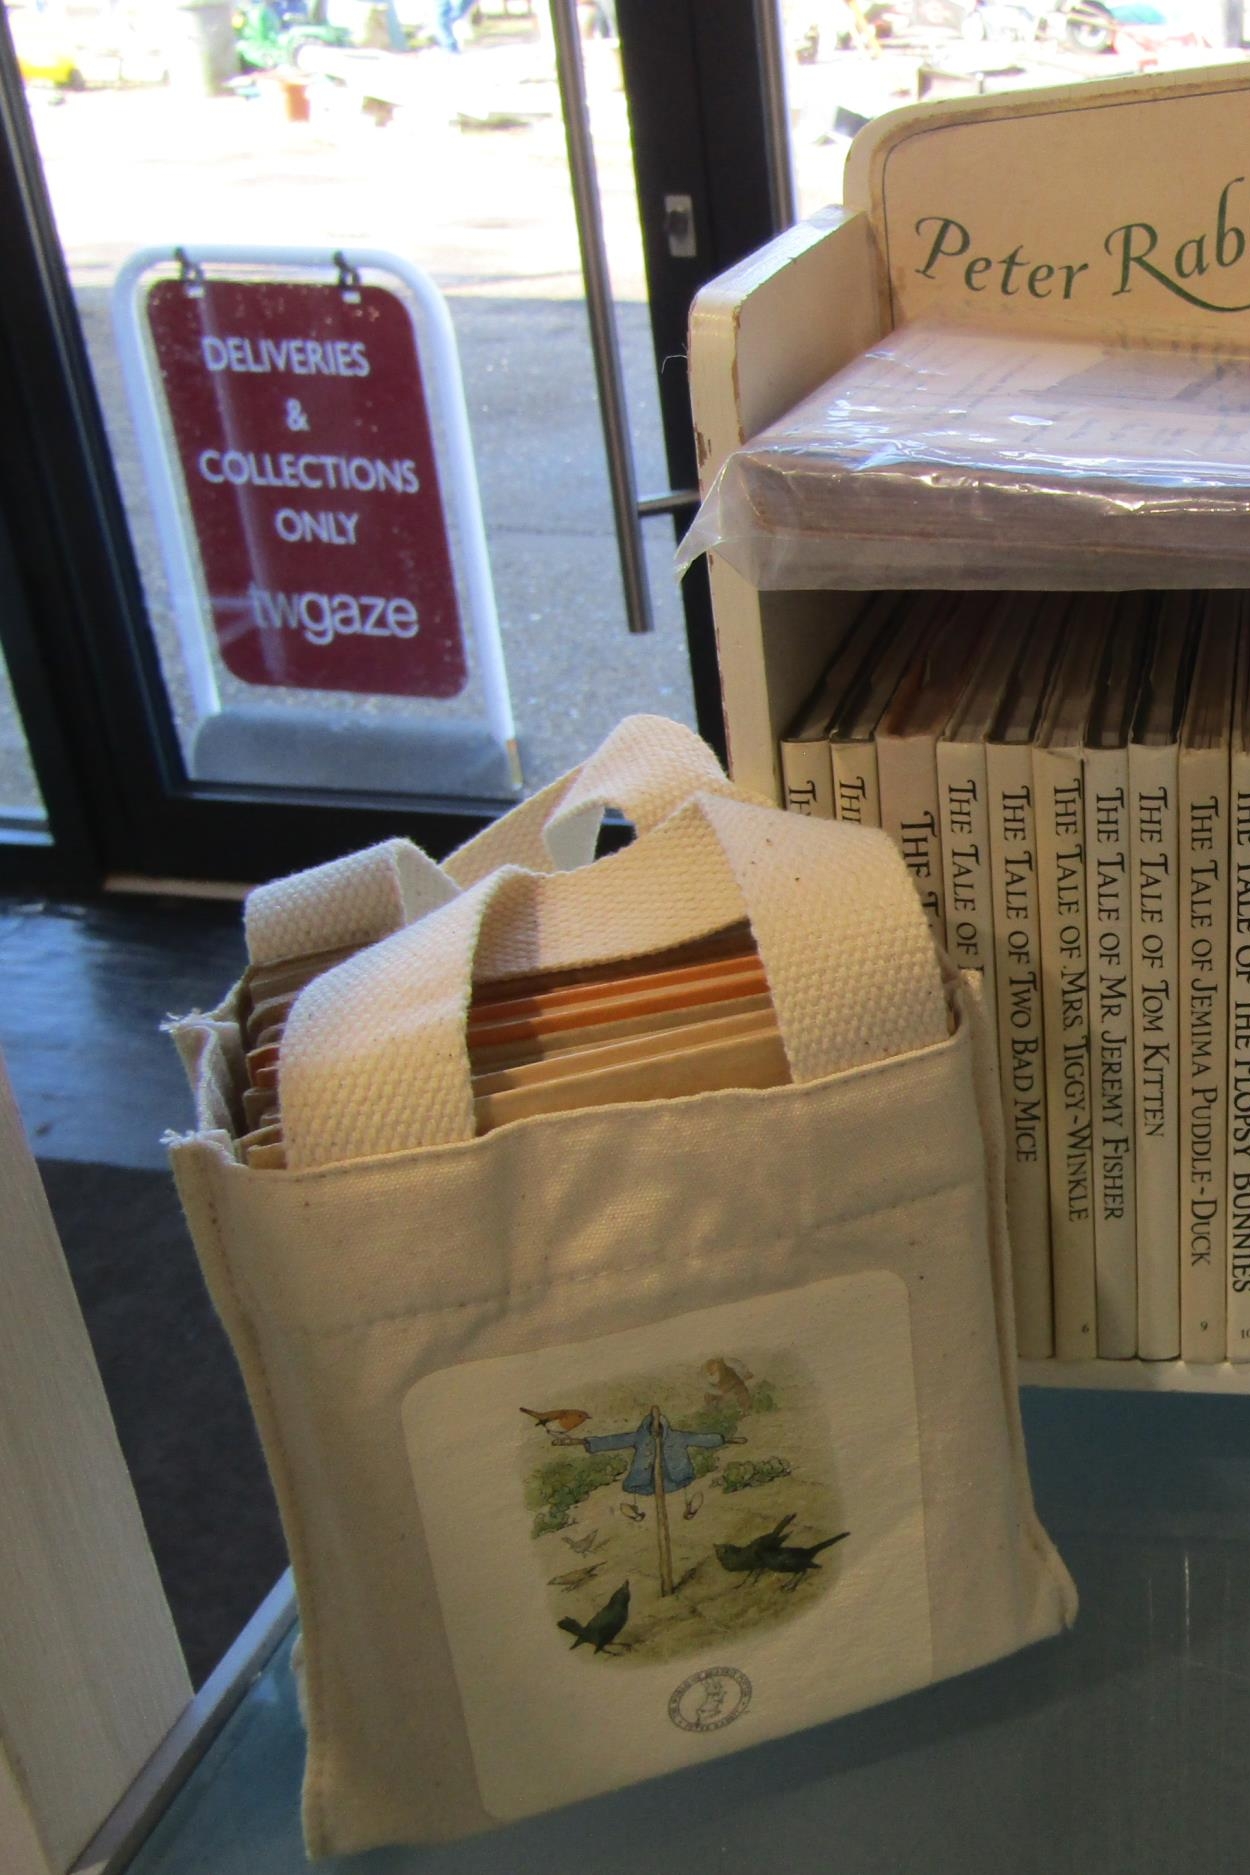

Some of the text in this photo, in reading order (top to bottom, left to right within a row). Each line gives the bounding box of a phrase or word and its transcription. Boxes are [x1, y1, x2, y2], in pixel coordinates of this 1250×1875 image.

[914, 216, 1089, 300] Peter
[202, 336, 370, 378] DELIVERIES
[285, 399, 310, 433] &
[198, 450, 419, 495] COLLECTIONS
[275, 508, 360, 545] ONLY
[248, 583, 419, 646] twgaze
[788, 780, 817, 816] TH
[839, 776, 866, 824] TH
[948, 780, 977, 835] THE
[1053, 778, 1082, 837] THE
[1096, 786, 1125, 844] THE
[1190, 796, 1219, 851] THE
[900, 810, 938, 880] THE
[951, 844, 980, 912] TALE
[1056, 844, 1085, 916] TALE
[1097, 852, 1125, 922] TALE
[1190, 859, 1219, 929] TALE
[955, 922, 979, 956] OF
[1059, 925, 1081, 959] OF
[1099, 932, 1121, 966] OF
[1139, 786, 1170, 1138] THE TALE OF TOM KITTEN
[1191, 938, 1213, 972] OF
[1002, 785, 1041, 1163] THE TALE OF TWO BAD MICE
[1190, 978, 1218, 1078] JEMIMA
[1101, 1030, 1127, 1128] JEREMY
[1103, 1135, 1130, 1221] FISHER
[1200, 1320, 1208, 1333] 9
